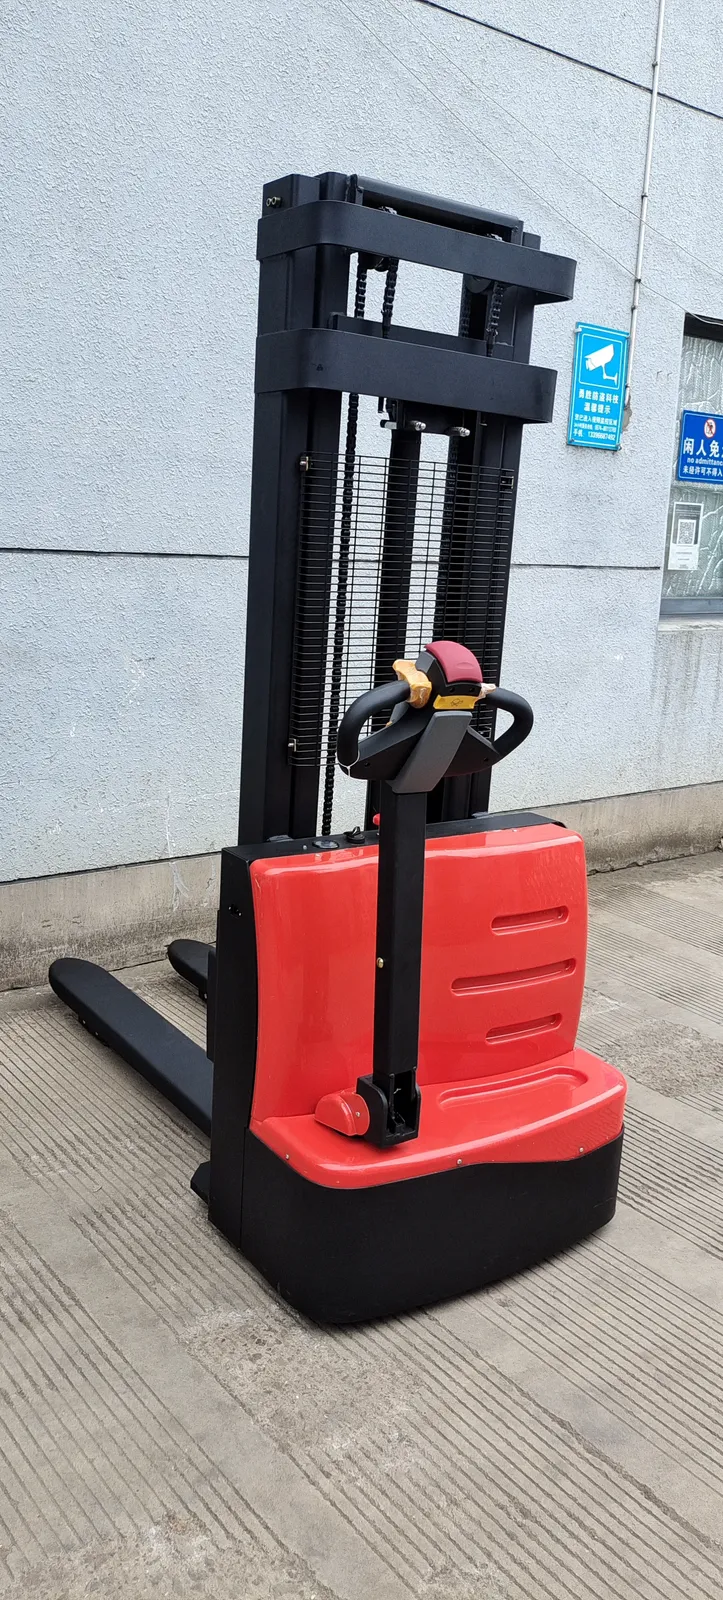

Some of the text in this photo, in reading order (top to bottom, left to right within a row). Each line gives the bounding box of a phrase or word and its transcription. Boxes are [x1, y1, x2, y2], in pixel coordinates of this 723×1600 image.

[583, 402, 611, 415] 温馨提示
[683, 437, 723, 458] 闲人免
